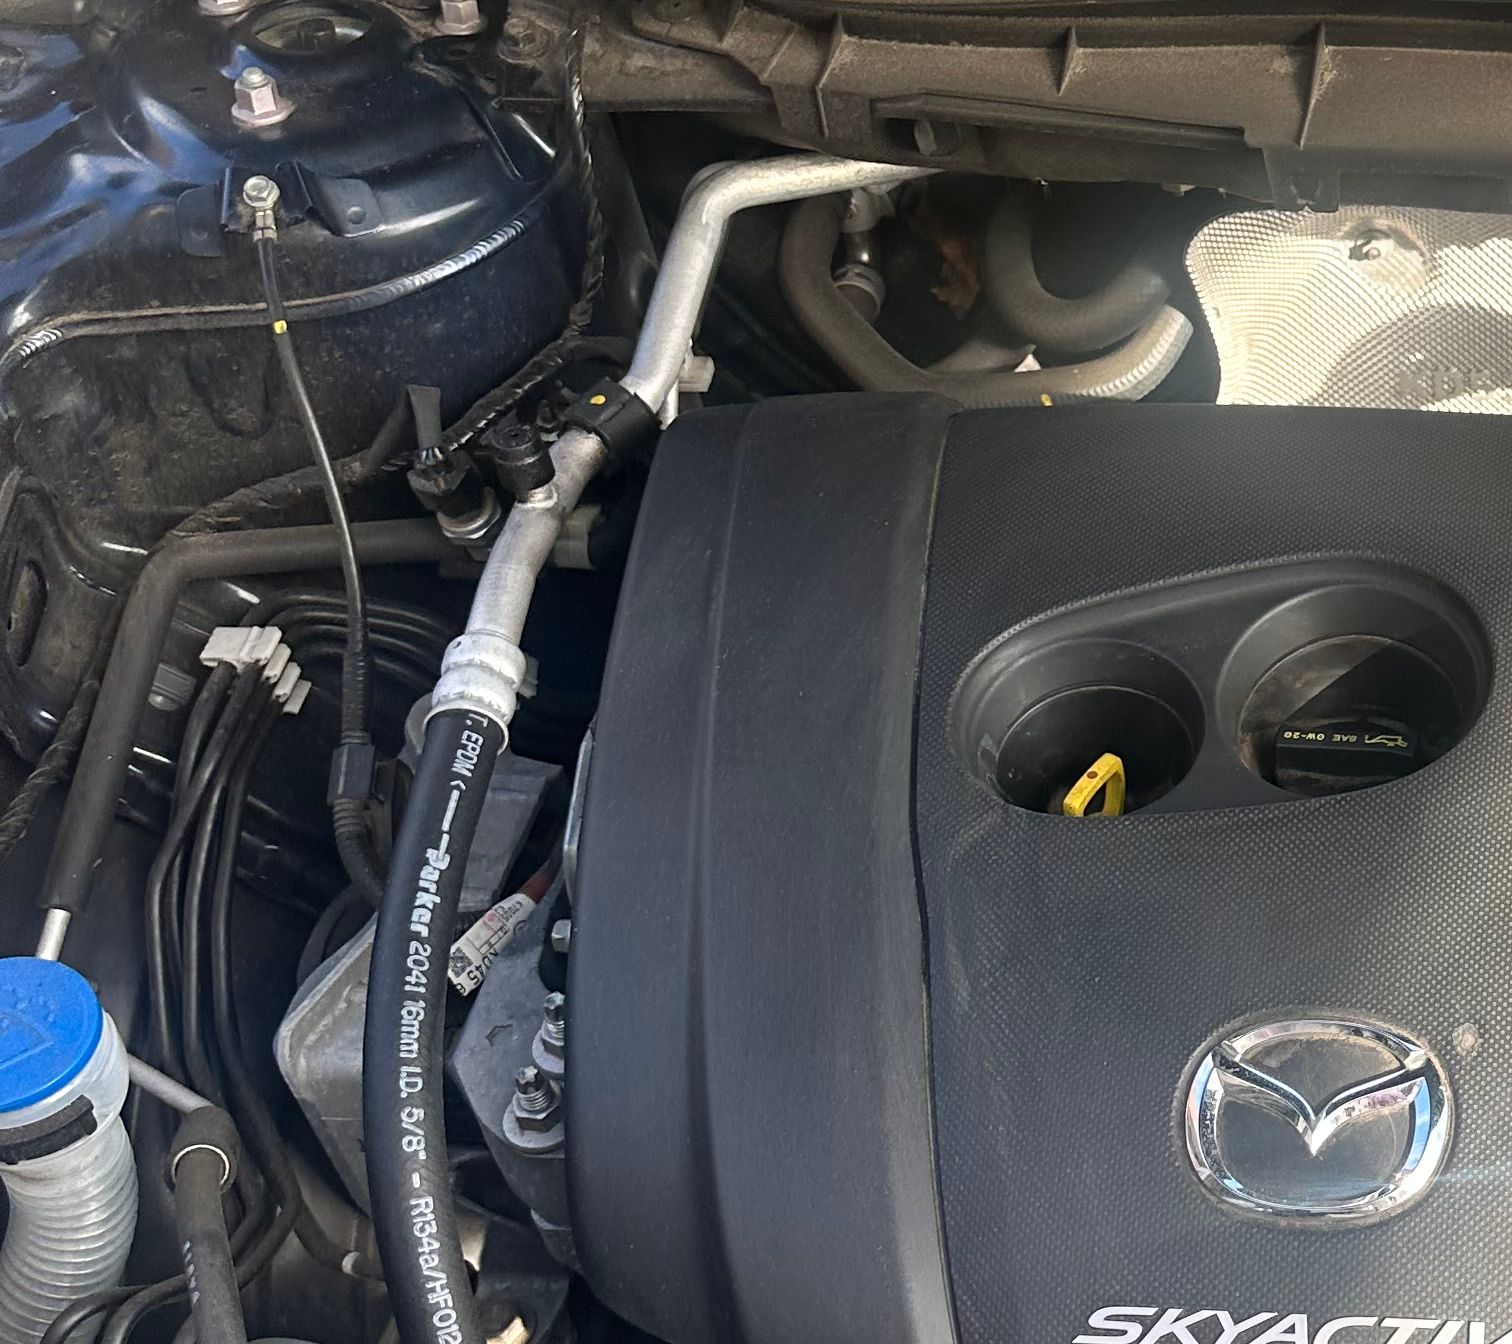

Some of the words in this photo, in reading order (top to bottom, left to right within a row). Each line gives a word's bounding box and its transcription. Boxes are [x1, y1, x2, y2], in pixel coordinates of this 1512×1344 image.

[451, 730, 483, 777] EPDM
[1283, 731, 1326, 741] 0W-20
[410, 847, 450, 937] Parker
[403, 941, 432, 993] 2041
[398, 1000, 426, 1059] 16mm
[398, 1065, 423, 1099] I.D.
[399, 1105, 429, 1162] 5/8"
